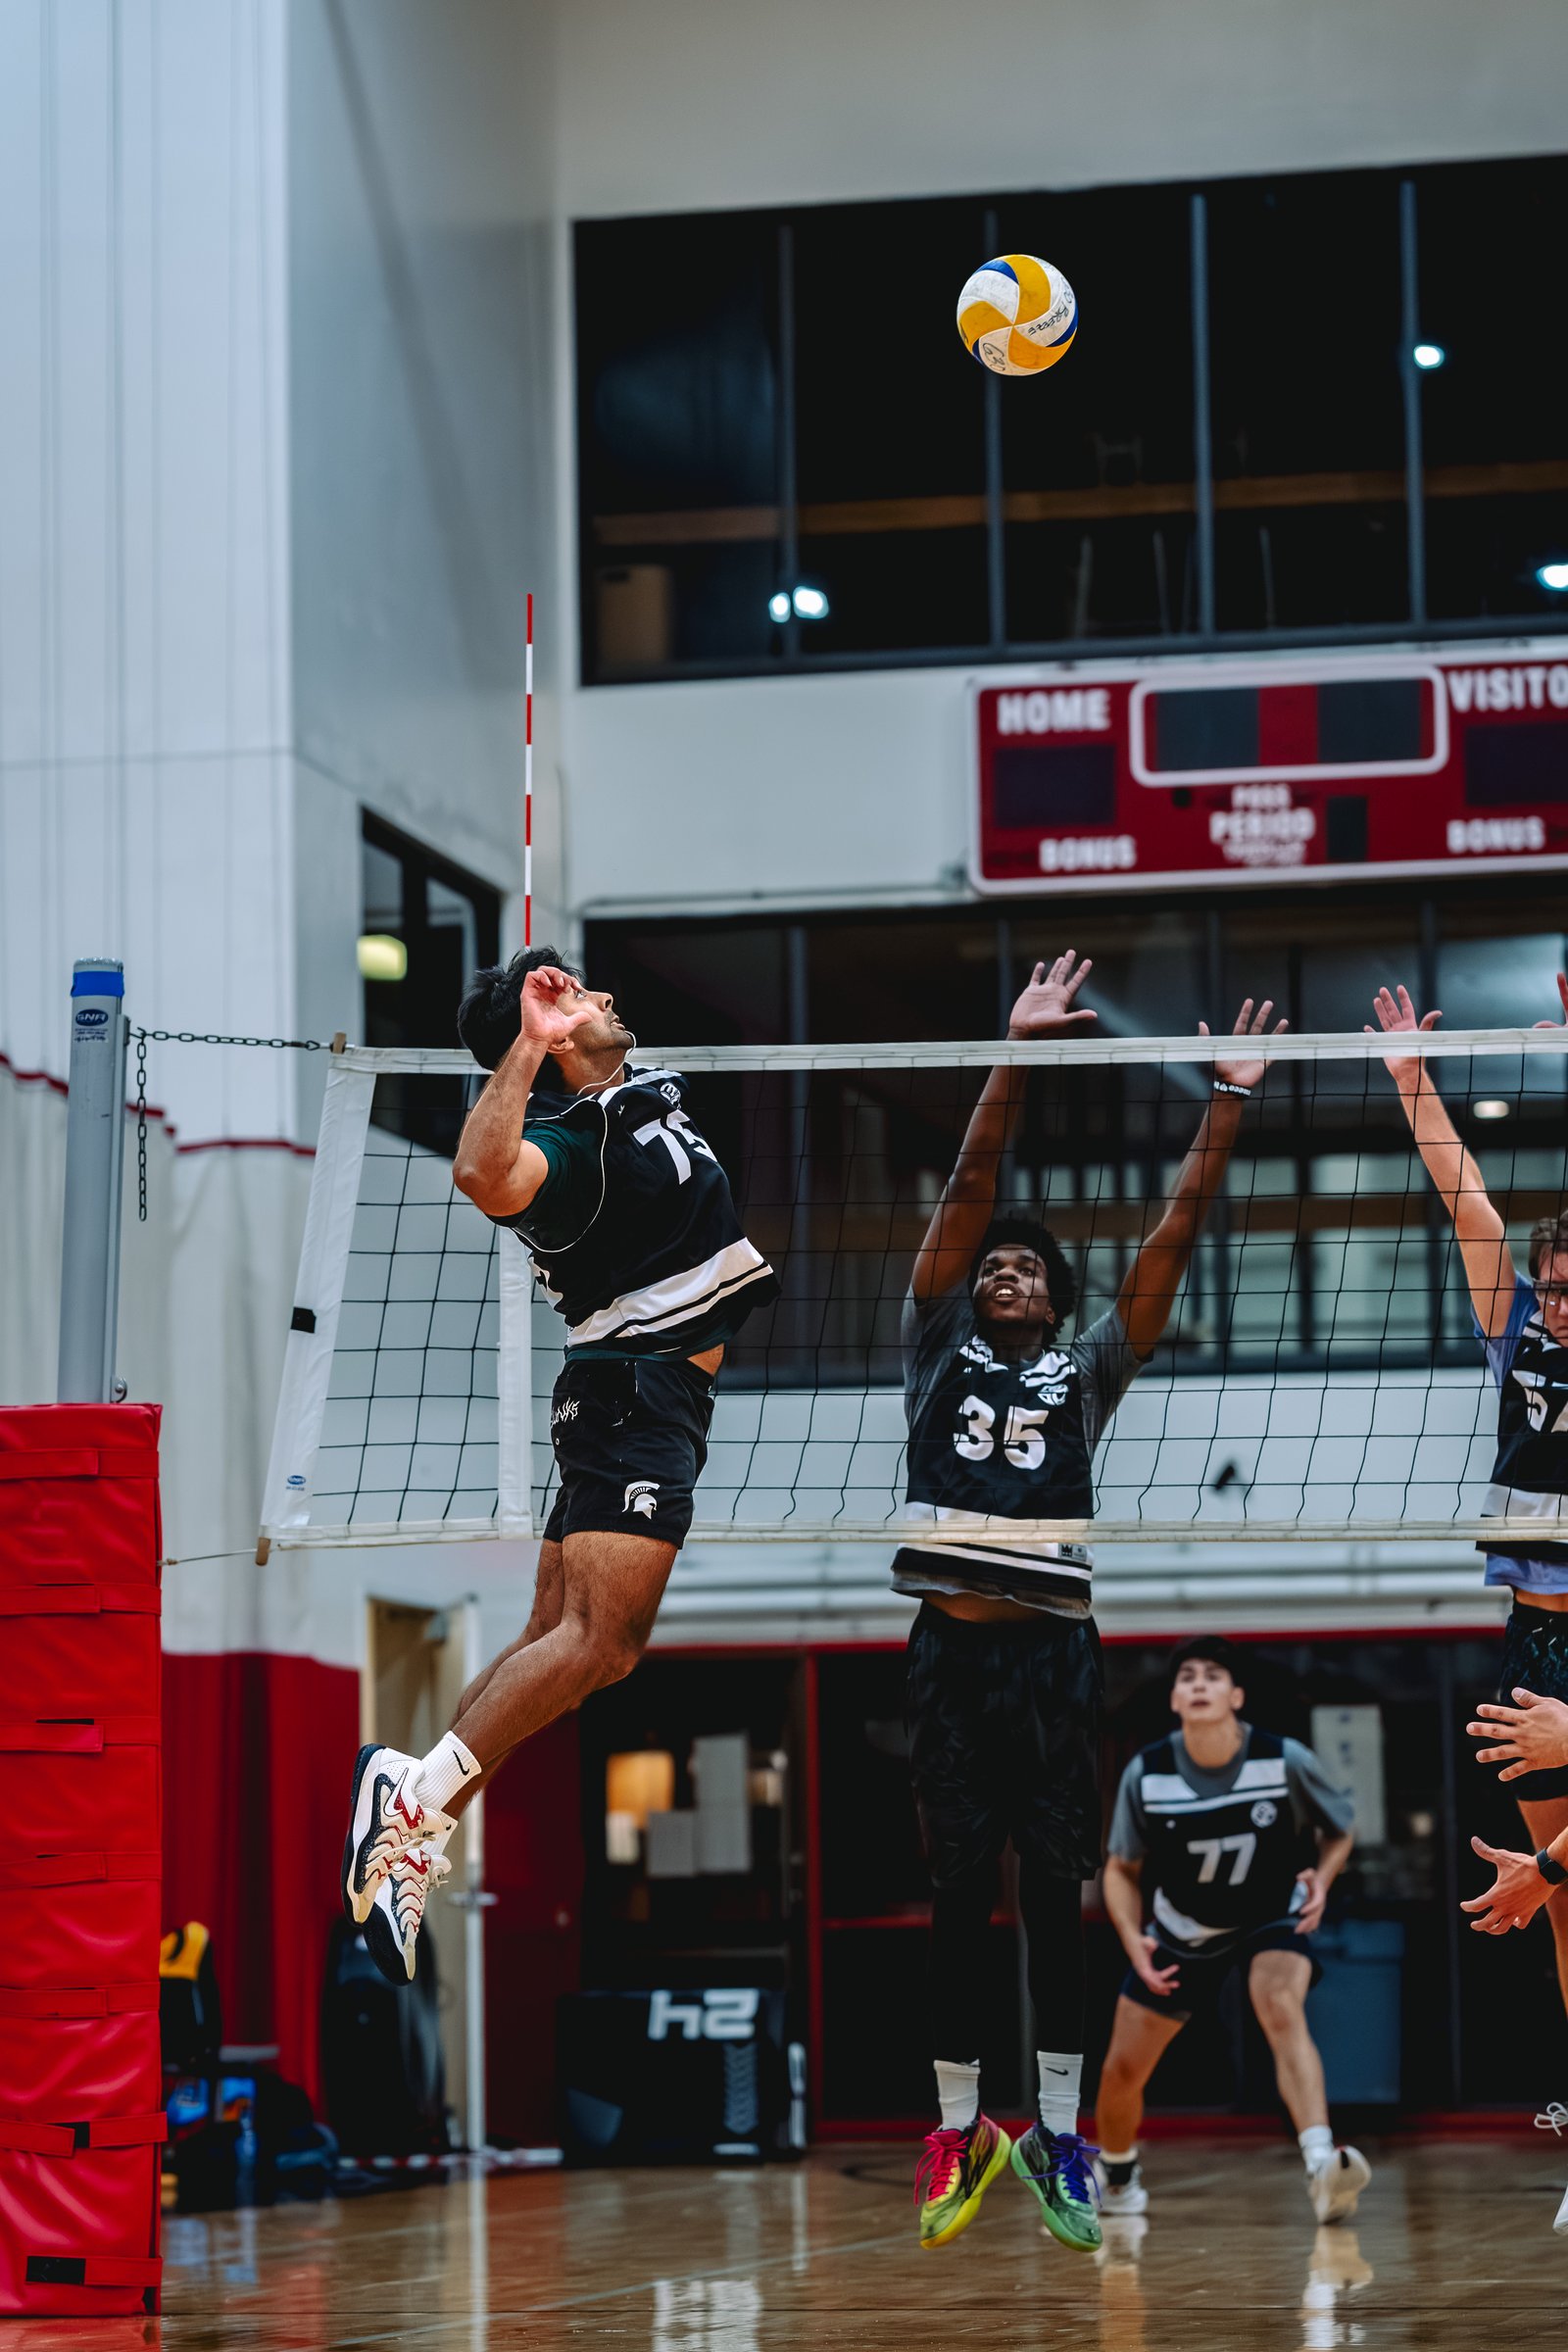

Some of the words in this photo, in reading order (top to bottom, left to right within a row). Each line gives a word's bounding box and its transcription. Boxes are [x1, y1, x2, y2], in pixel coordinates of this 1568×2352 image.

[1447, 665, 1568, 712] VISITO
[998, 689, 1111, 735] HOME
[1039, 835, 1137, 872] BONUS
[1446, 815, 1545, 854] BONUS
[953, 1395, 1050, 1470] 35
[1187, 1832, 1256, 1886] 77
